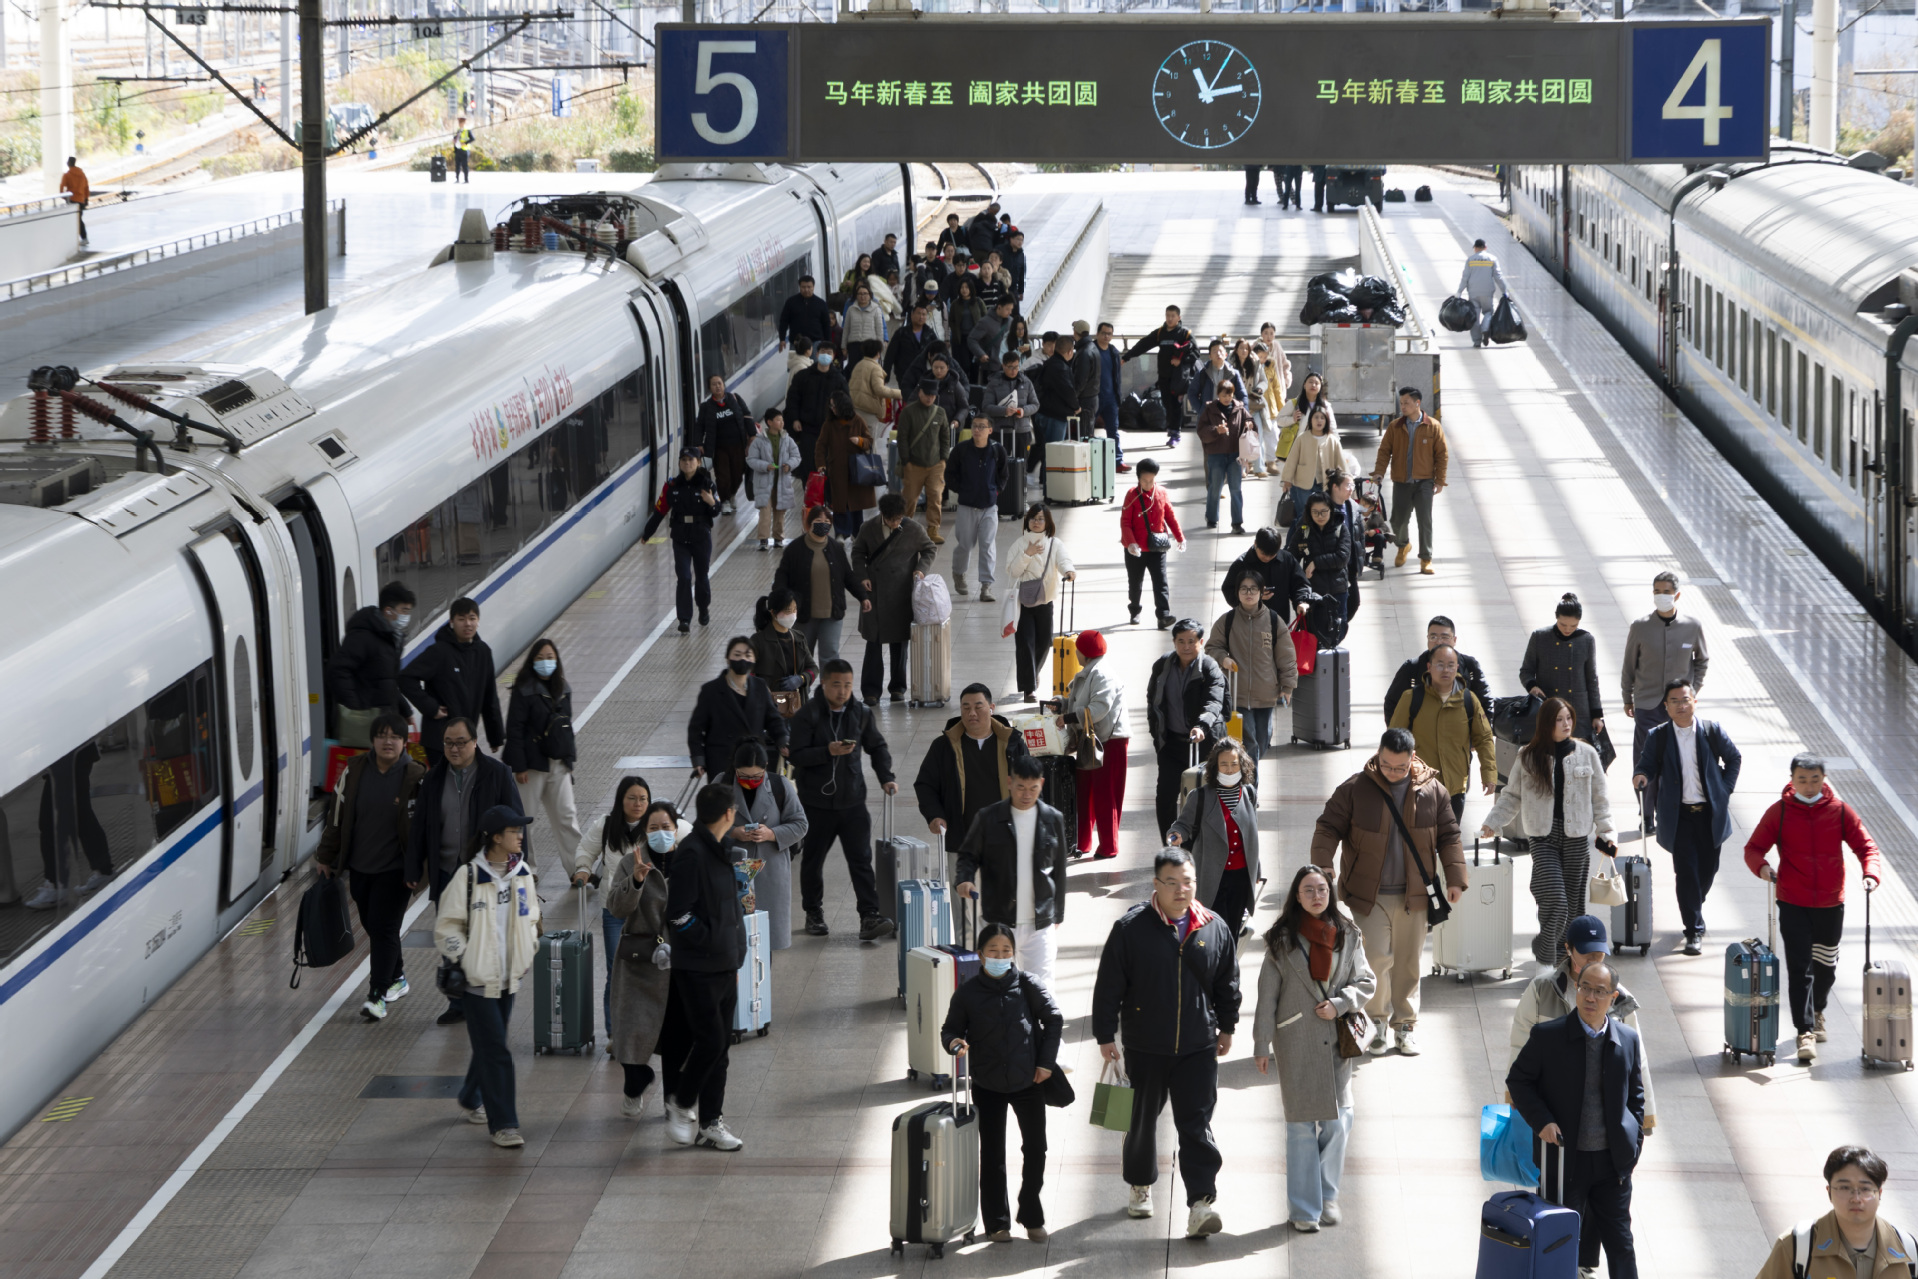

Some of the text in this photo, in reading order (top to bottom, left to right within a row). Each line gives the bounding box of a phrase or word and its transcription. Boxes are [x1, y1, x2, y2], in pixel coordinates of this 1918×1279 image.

[177, 14, 207, 25] 143
[413, 26, 443, 39] 104
[690, 40, 760, 145] 5
[825, 80, 1097, 106] 马年新春至 阖家共团圆
[1315, 79, 1592, 105] 马年新春至 阖家共团圆
[1661, 38, 1734, 146] 4
